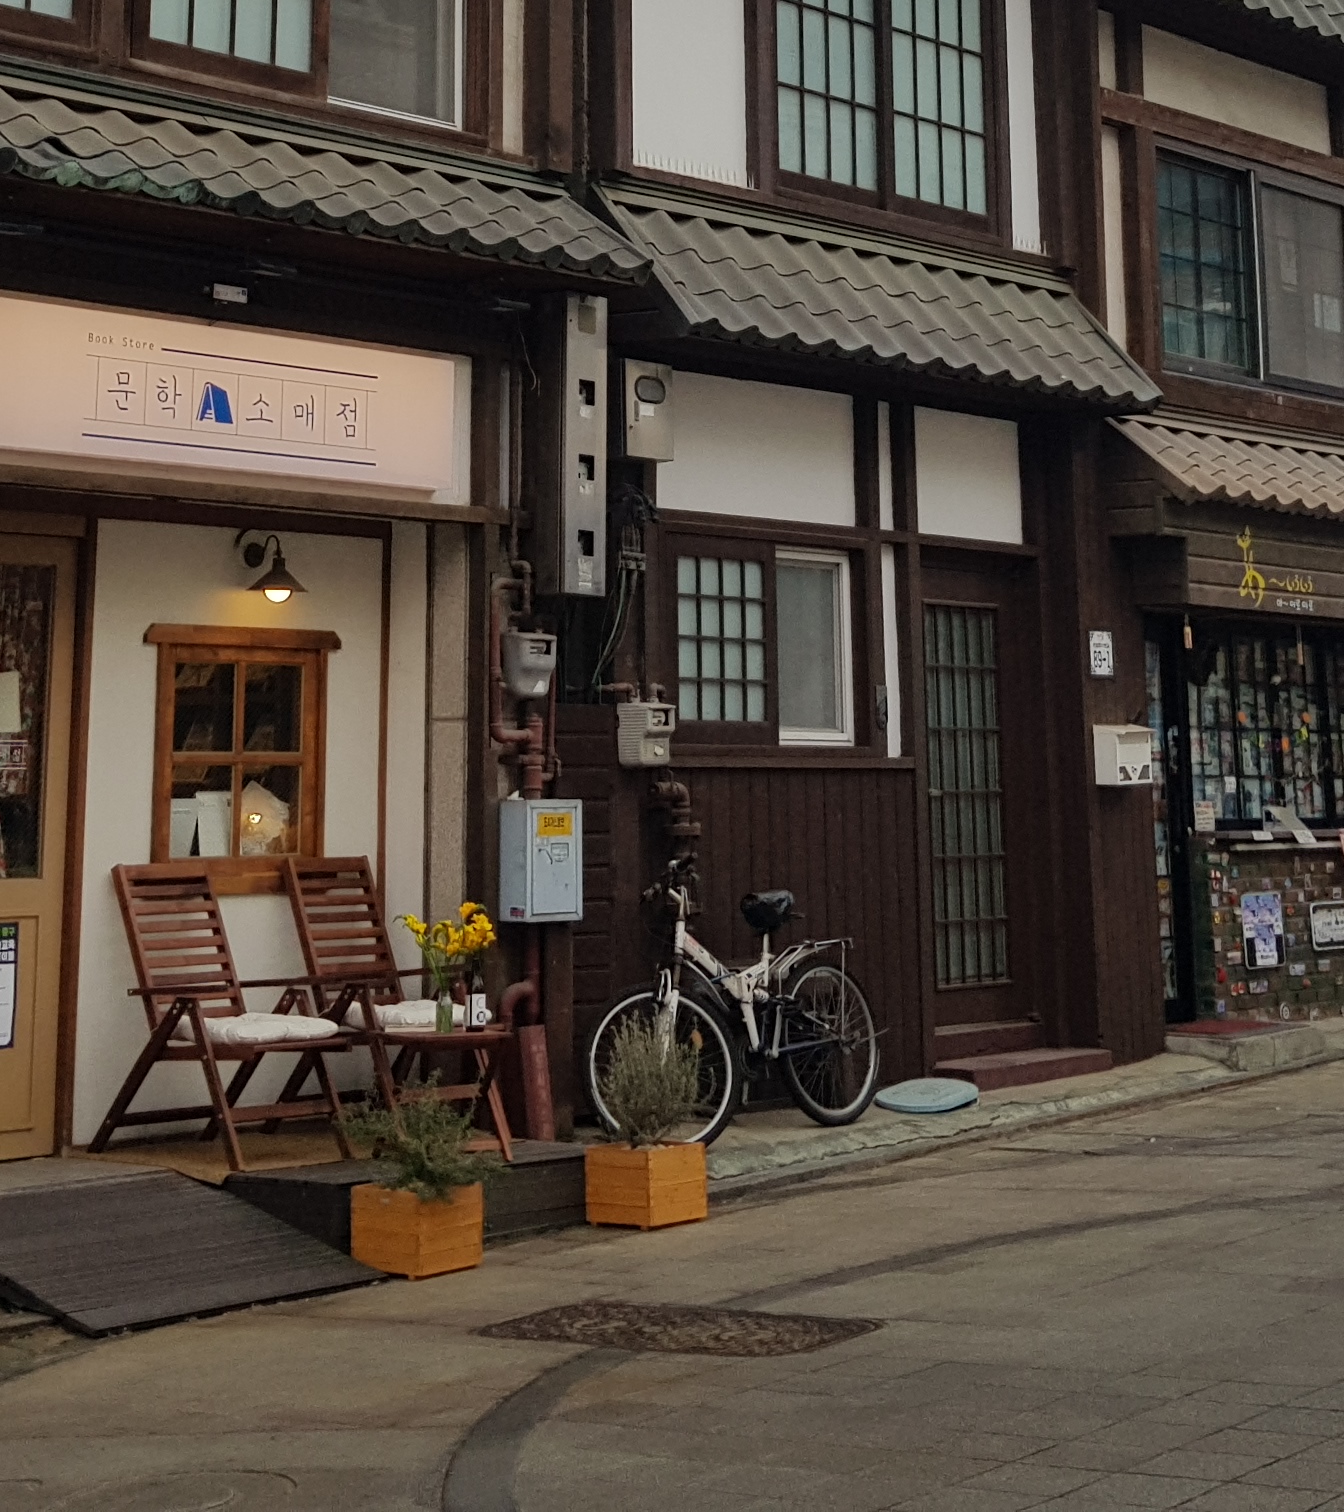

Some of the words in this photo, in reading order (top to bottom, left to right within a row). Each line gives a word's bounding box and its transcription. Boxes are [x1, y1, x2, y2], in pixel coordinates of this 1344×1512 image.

[87, 331, 115, 346] Book
[121, 336, 155, 351] Store
[106, 370, 183, 419] 문학
[245, 392, 358, 439] 소매점
